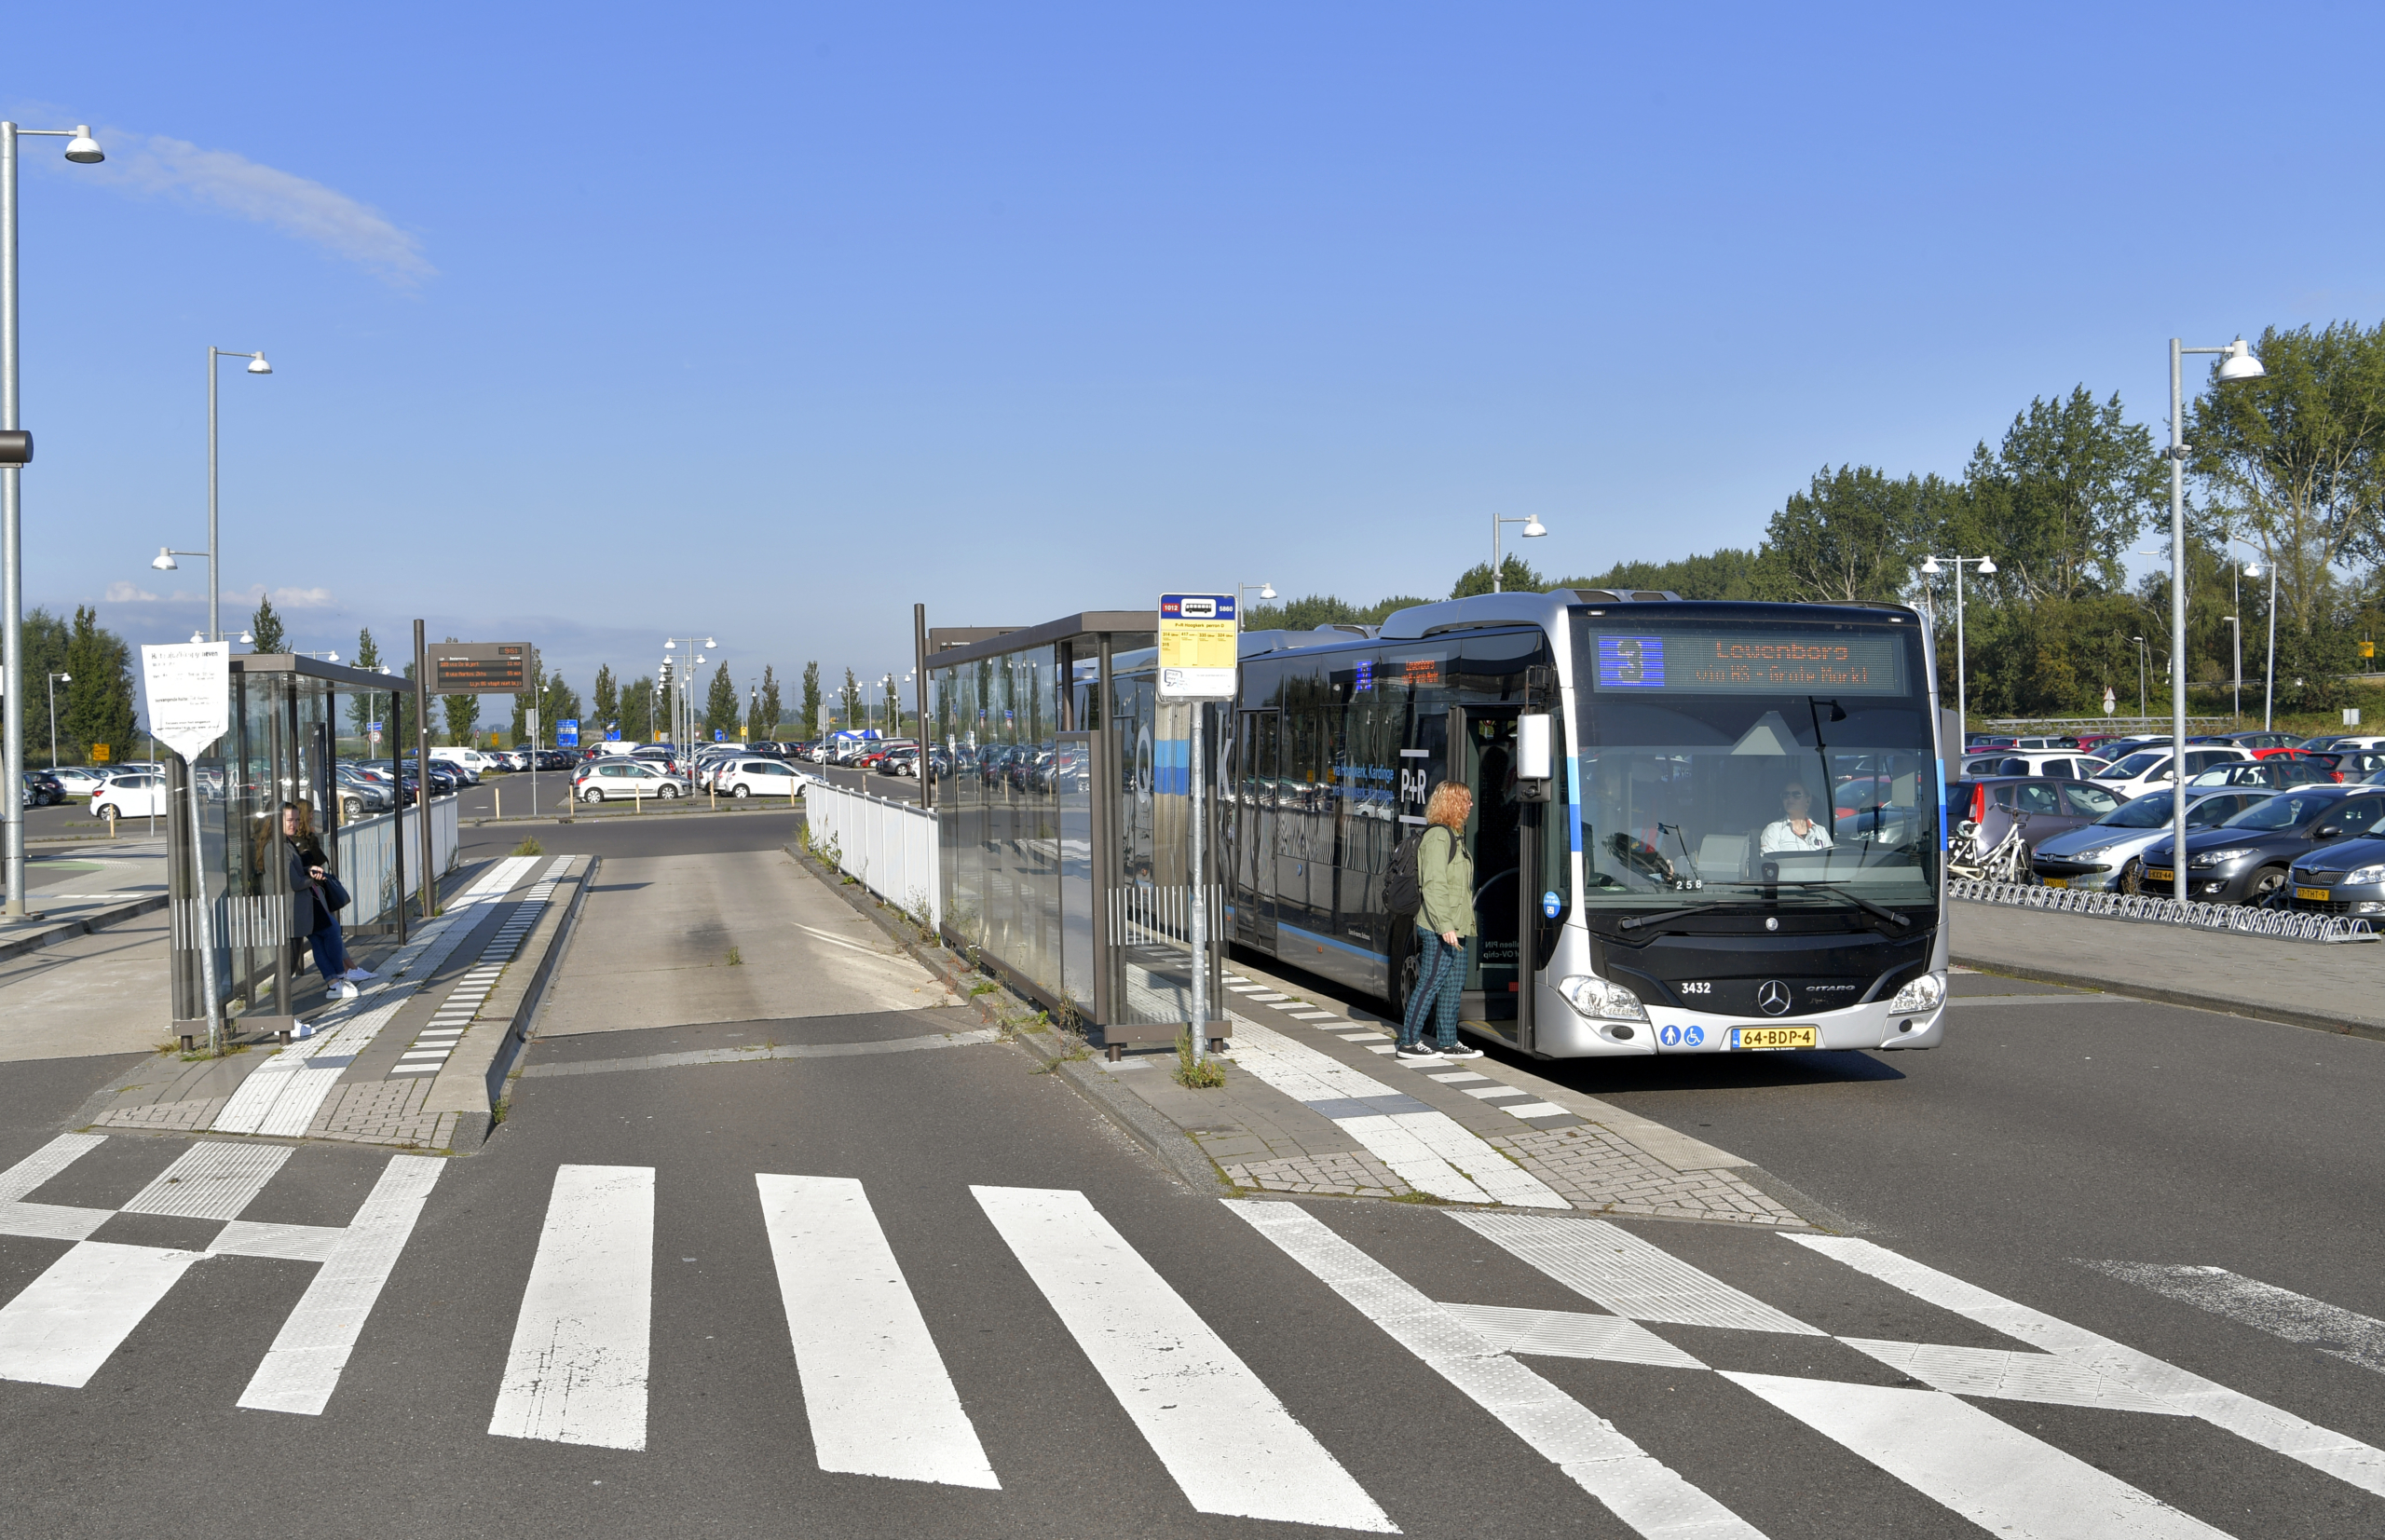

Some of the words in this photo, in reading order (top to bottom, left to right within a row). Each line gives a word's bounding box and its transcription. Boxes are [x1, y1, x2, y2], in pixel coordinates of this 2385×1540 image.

[1715, 640, 1848, 661] Lewenborg
[1616, 639, 1642, 684] 3
[1696, 664, 1727, 682] via
[1730, 665, 1751, 683] HS
[1768, 665, 1816, 683] Grote
[1820, 666, 1869, 684] Markt
[1369, 763, 1395, 784] Kardinge
[1400, 768, 1427, 805] P+R
[2297, 889, 2325, 899] 07-THT-9
[1682, 982, 1711, 994] 3432
[1744, 1030, 1811, 1045] 64-BDP-4
